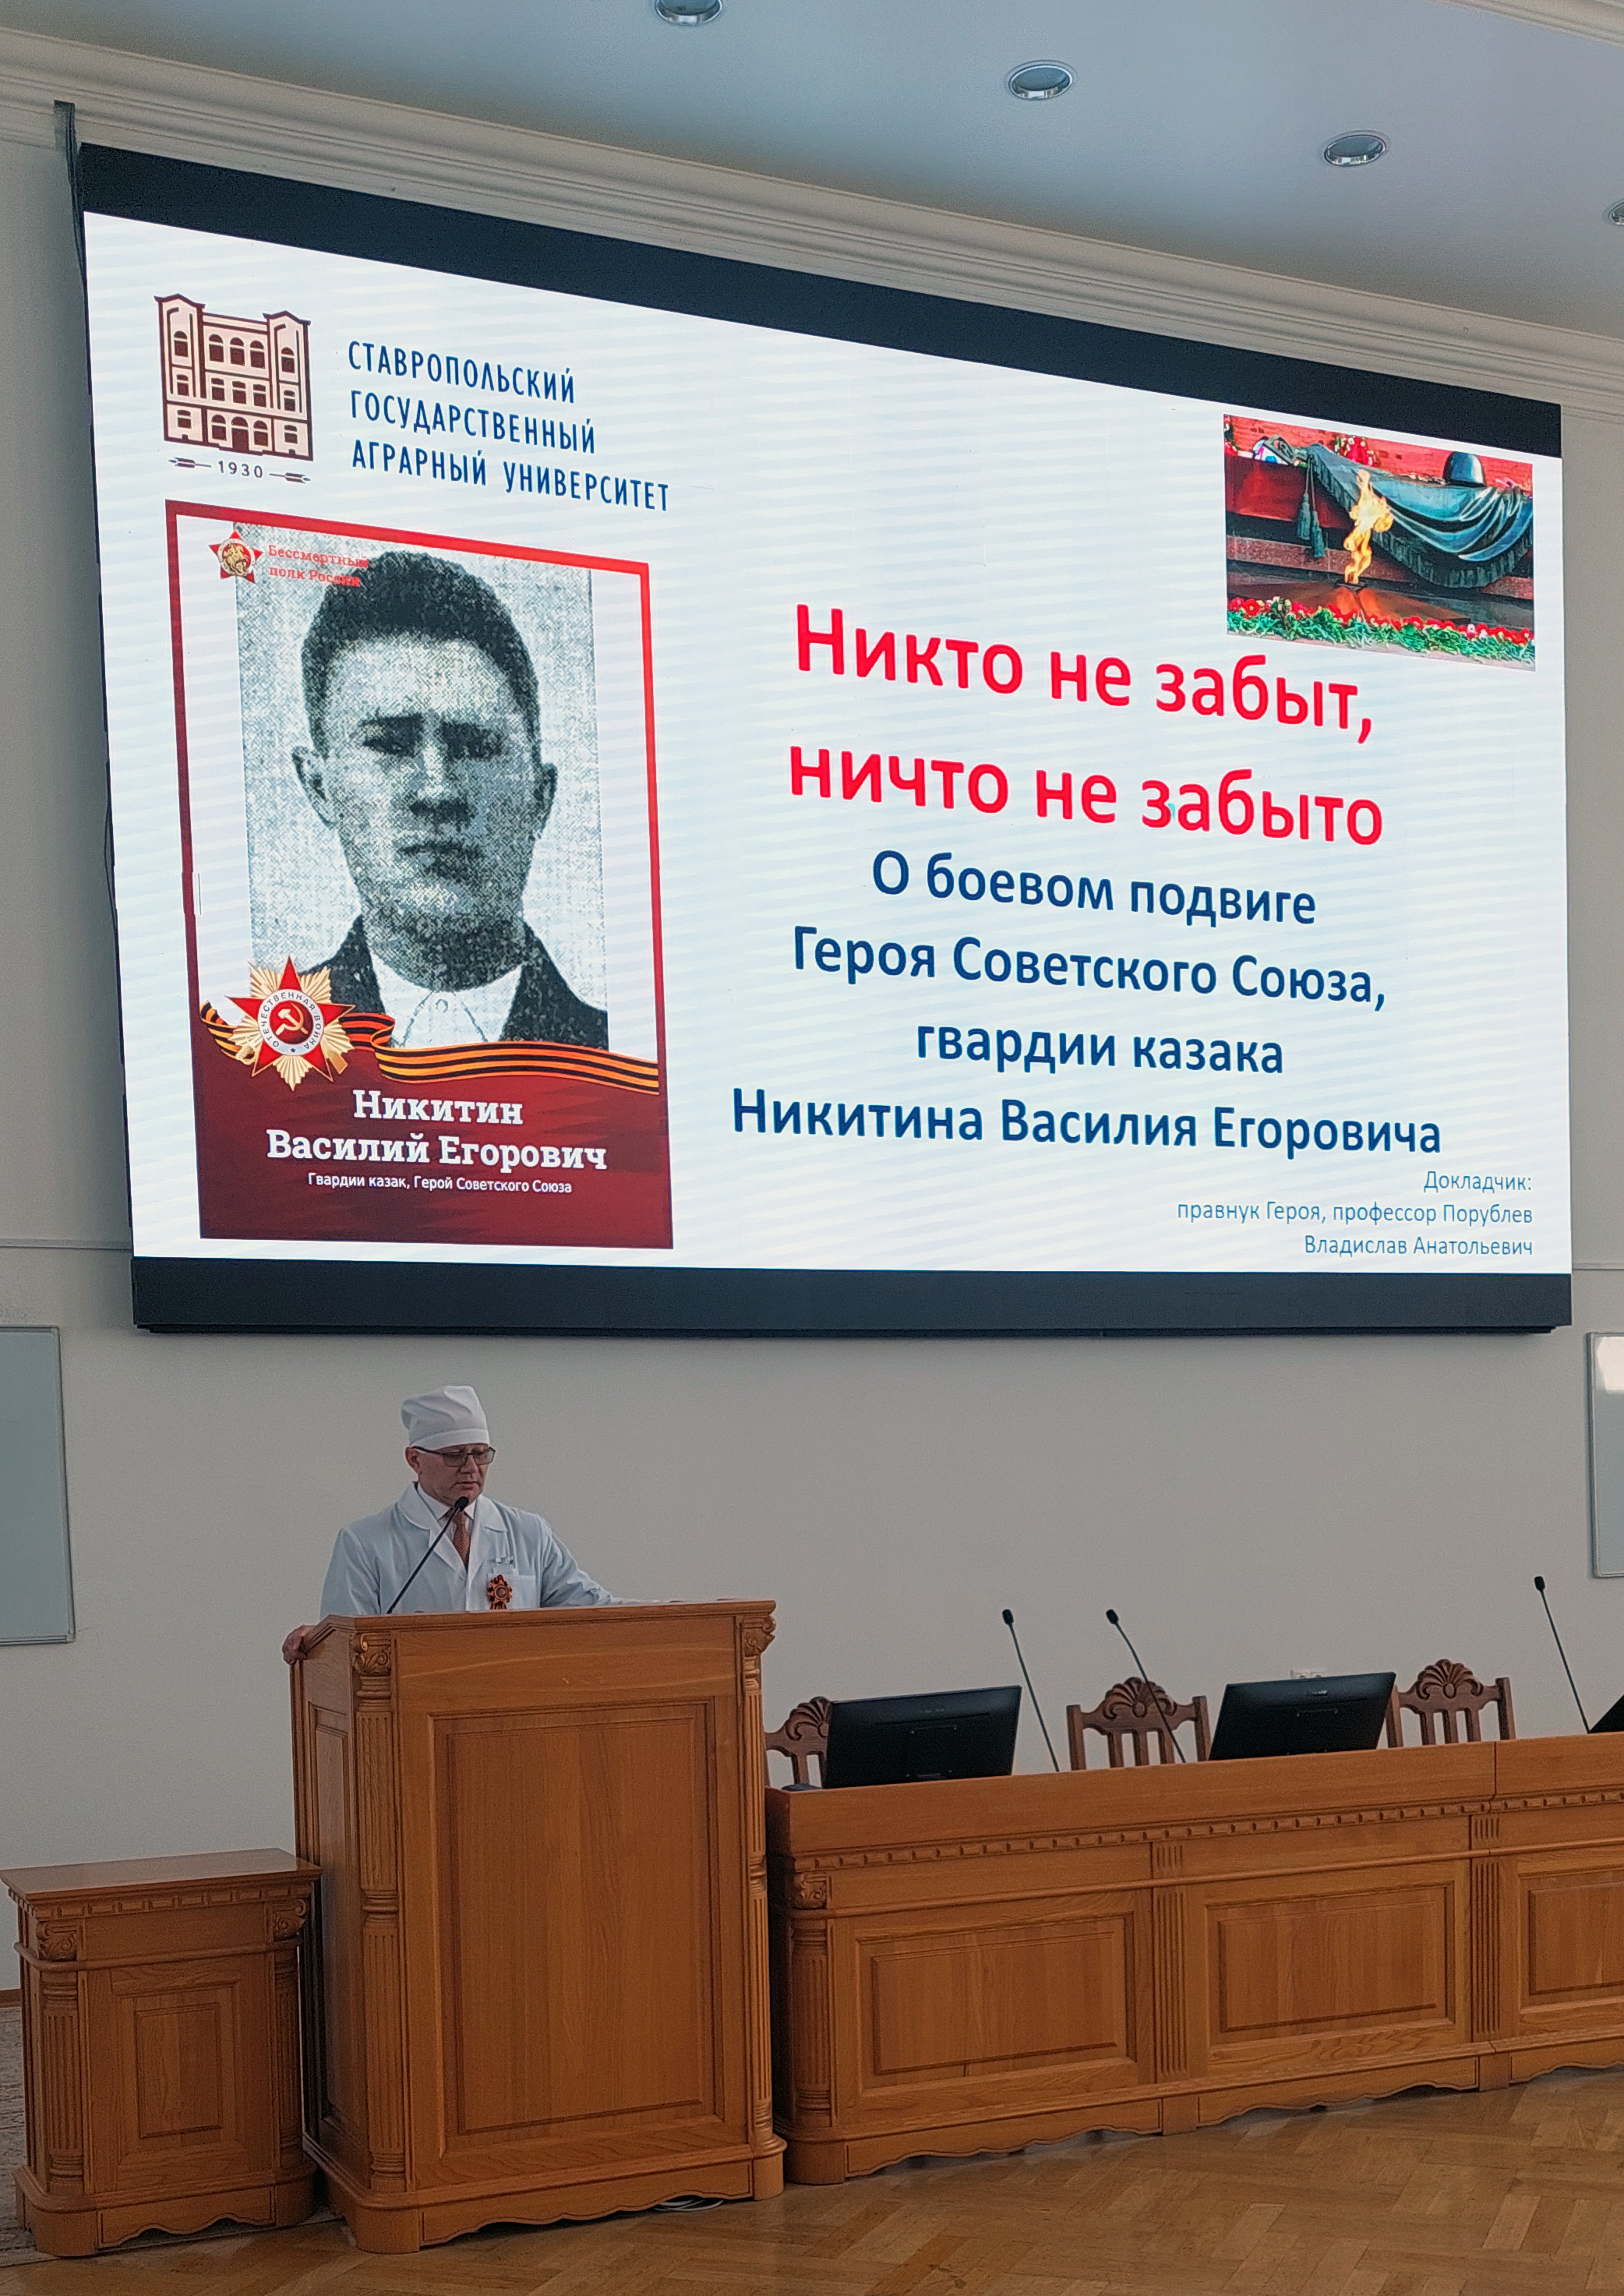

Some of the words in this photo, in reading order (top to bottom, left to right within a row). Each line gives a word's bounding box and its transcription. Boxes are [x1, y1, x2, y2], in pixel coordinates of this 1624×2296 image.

[349, 341, 574, 403] СТАВРОПОЛЬСКИЙ
[351, 389, 595, 454] ГОСУДАРСТВЕННЫЙ
[218, 461, 262, 478] 1930
[352, 440, 485, 486] АГРАРНЫЙ
[503, 461, 668, 511] УНИВЕРСИТЕТ
[269, 567, 304, 579] полк
[797, 604, 1022, 694] Никто
[1050, 652, 1131, 706] не
[1156, 655, 1372, 744] забыт,
[790, 746, 1008, 813] ничто
[1036, 770, 1116, 823] не
[1142, 769, 1382, 845] забыто
[873, 850, 909, 895] О
[927, 852, 1114, 910] боевом
[1132, 881, 1315, 927] подвиге
[795, 926, 935, 984] Героя
[954, 937, 1216, 994] Советского
[1233, 955, 1384, 1012] Союза,
[260, 992, 316, 1047] ОТЕЧЕСТВЕННАЯ
[303, 1015, 321, 1050] ВОЙНА
[918, 1026, 1115, 1074] гвардии
[1134, 1037, 1282, 1073] казака
[353, 1090, 523, 1124] Никитин
[733, 1088, 982, 1140] Никитина
[1002, 1099, 1196, 1146] Василия
[1214, 1107, 1440, 1160] Егоровича
[266, 1129, 429, 1164] Василий
[439, 1136, 606, 1173] Егорович
[309, 1173, 365, 1188] Гвардии
[369, 1176, 411, 1190] казак,
[415, 1176, 452, 1191] Герой
[457, 1178, 529, 1192] Советского
[533, 1180, 571, 1192] Союза
[1423, 1171, 1532, 1192] Докладчик:
[1177, 1203, 1260, 1224] правнук
[1266, 1201, 1326, 1224] Героя,
[1334, 1202, 1435, 1225] профессор
[1444, 1204, 1532, 1226] Порублев
[1305, 1235, 1407, 1256] Владислав
[1413, 1237, 1533, 1256] Анатольевич
